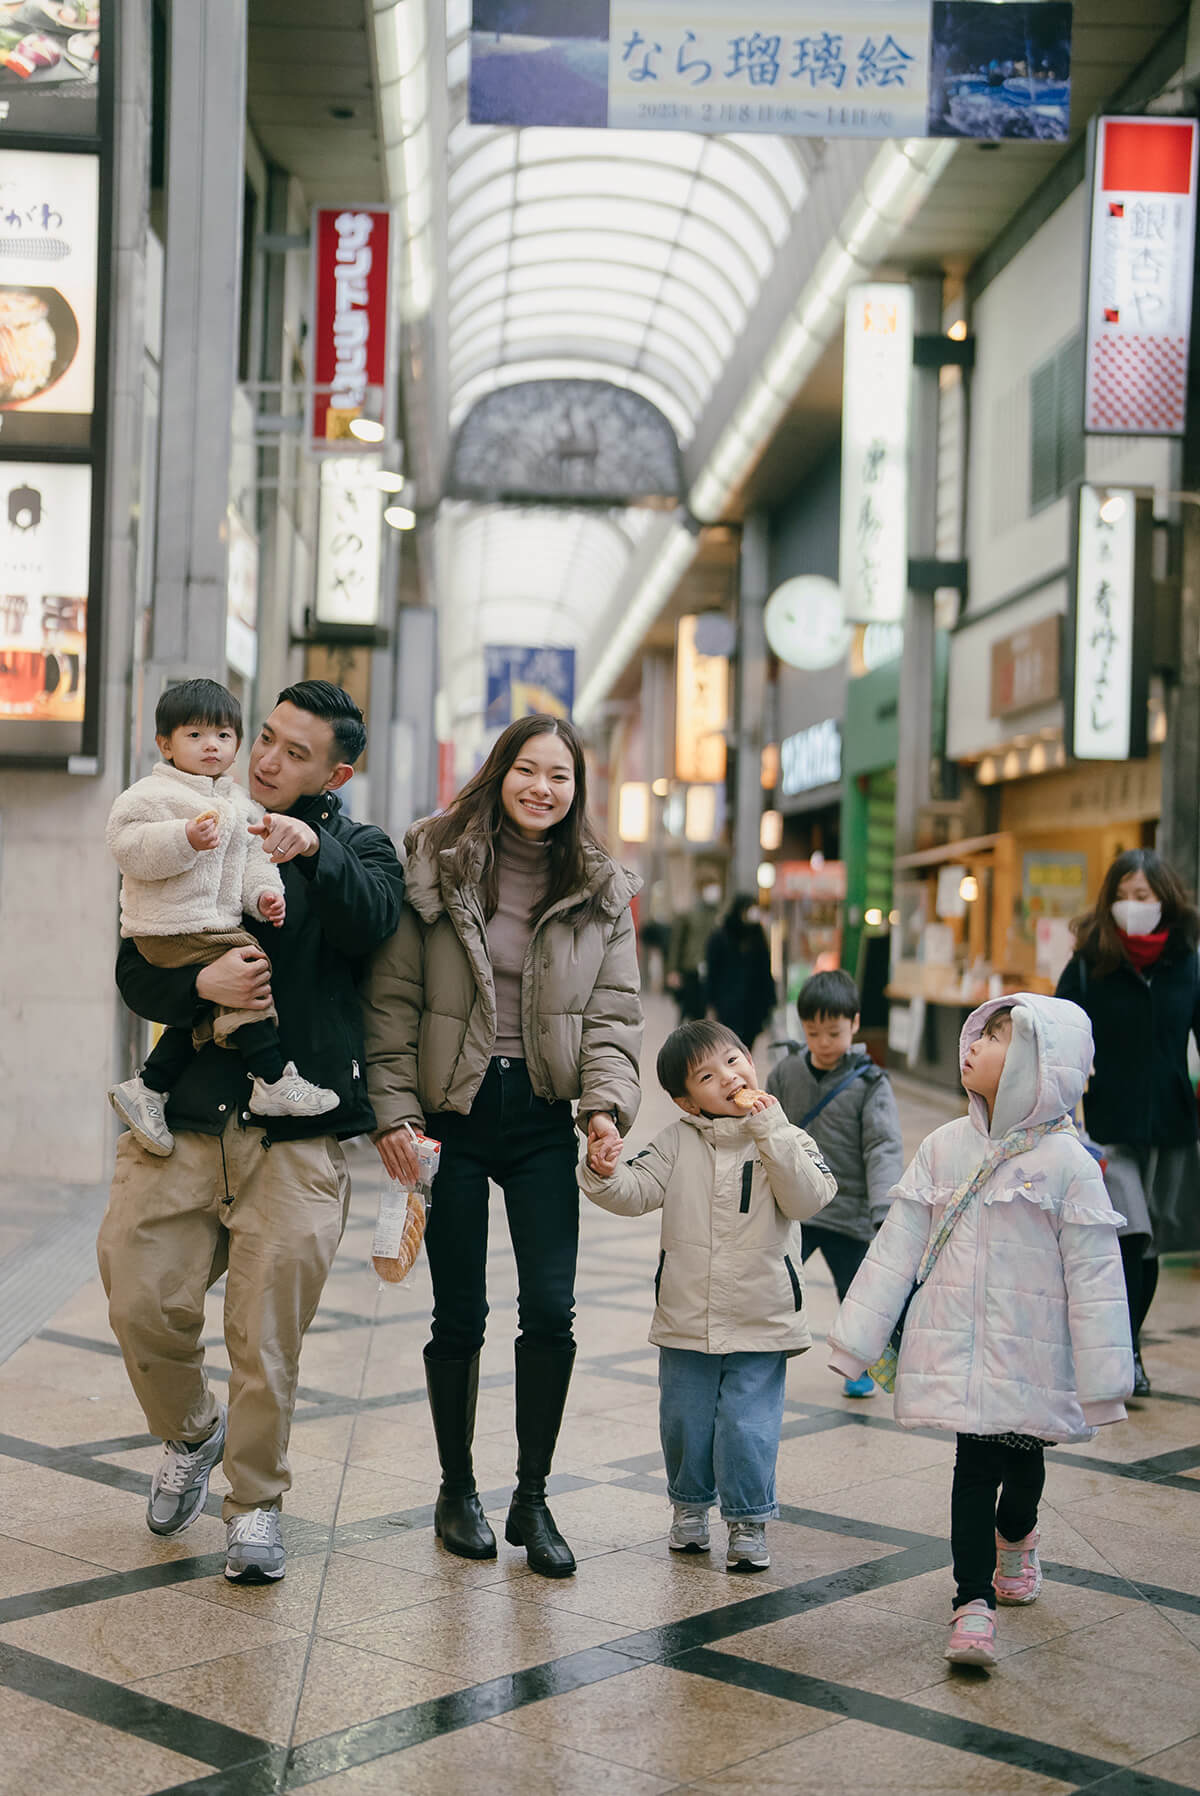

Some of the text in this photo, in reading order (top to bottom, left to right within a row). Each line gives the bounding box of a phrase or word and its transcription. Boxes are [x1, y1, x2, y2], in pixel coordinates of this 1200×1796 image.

[621, 29, 915, 89] なら瑠璃絵
[286, 1088, 304, 1103] N
